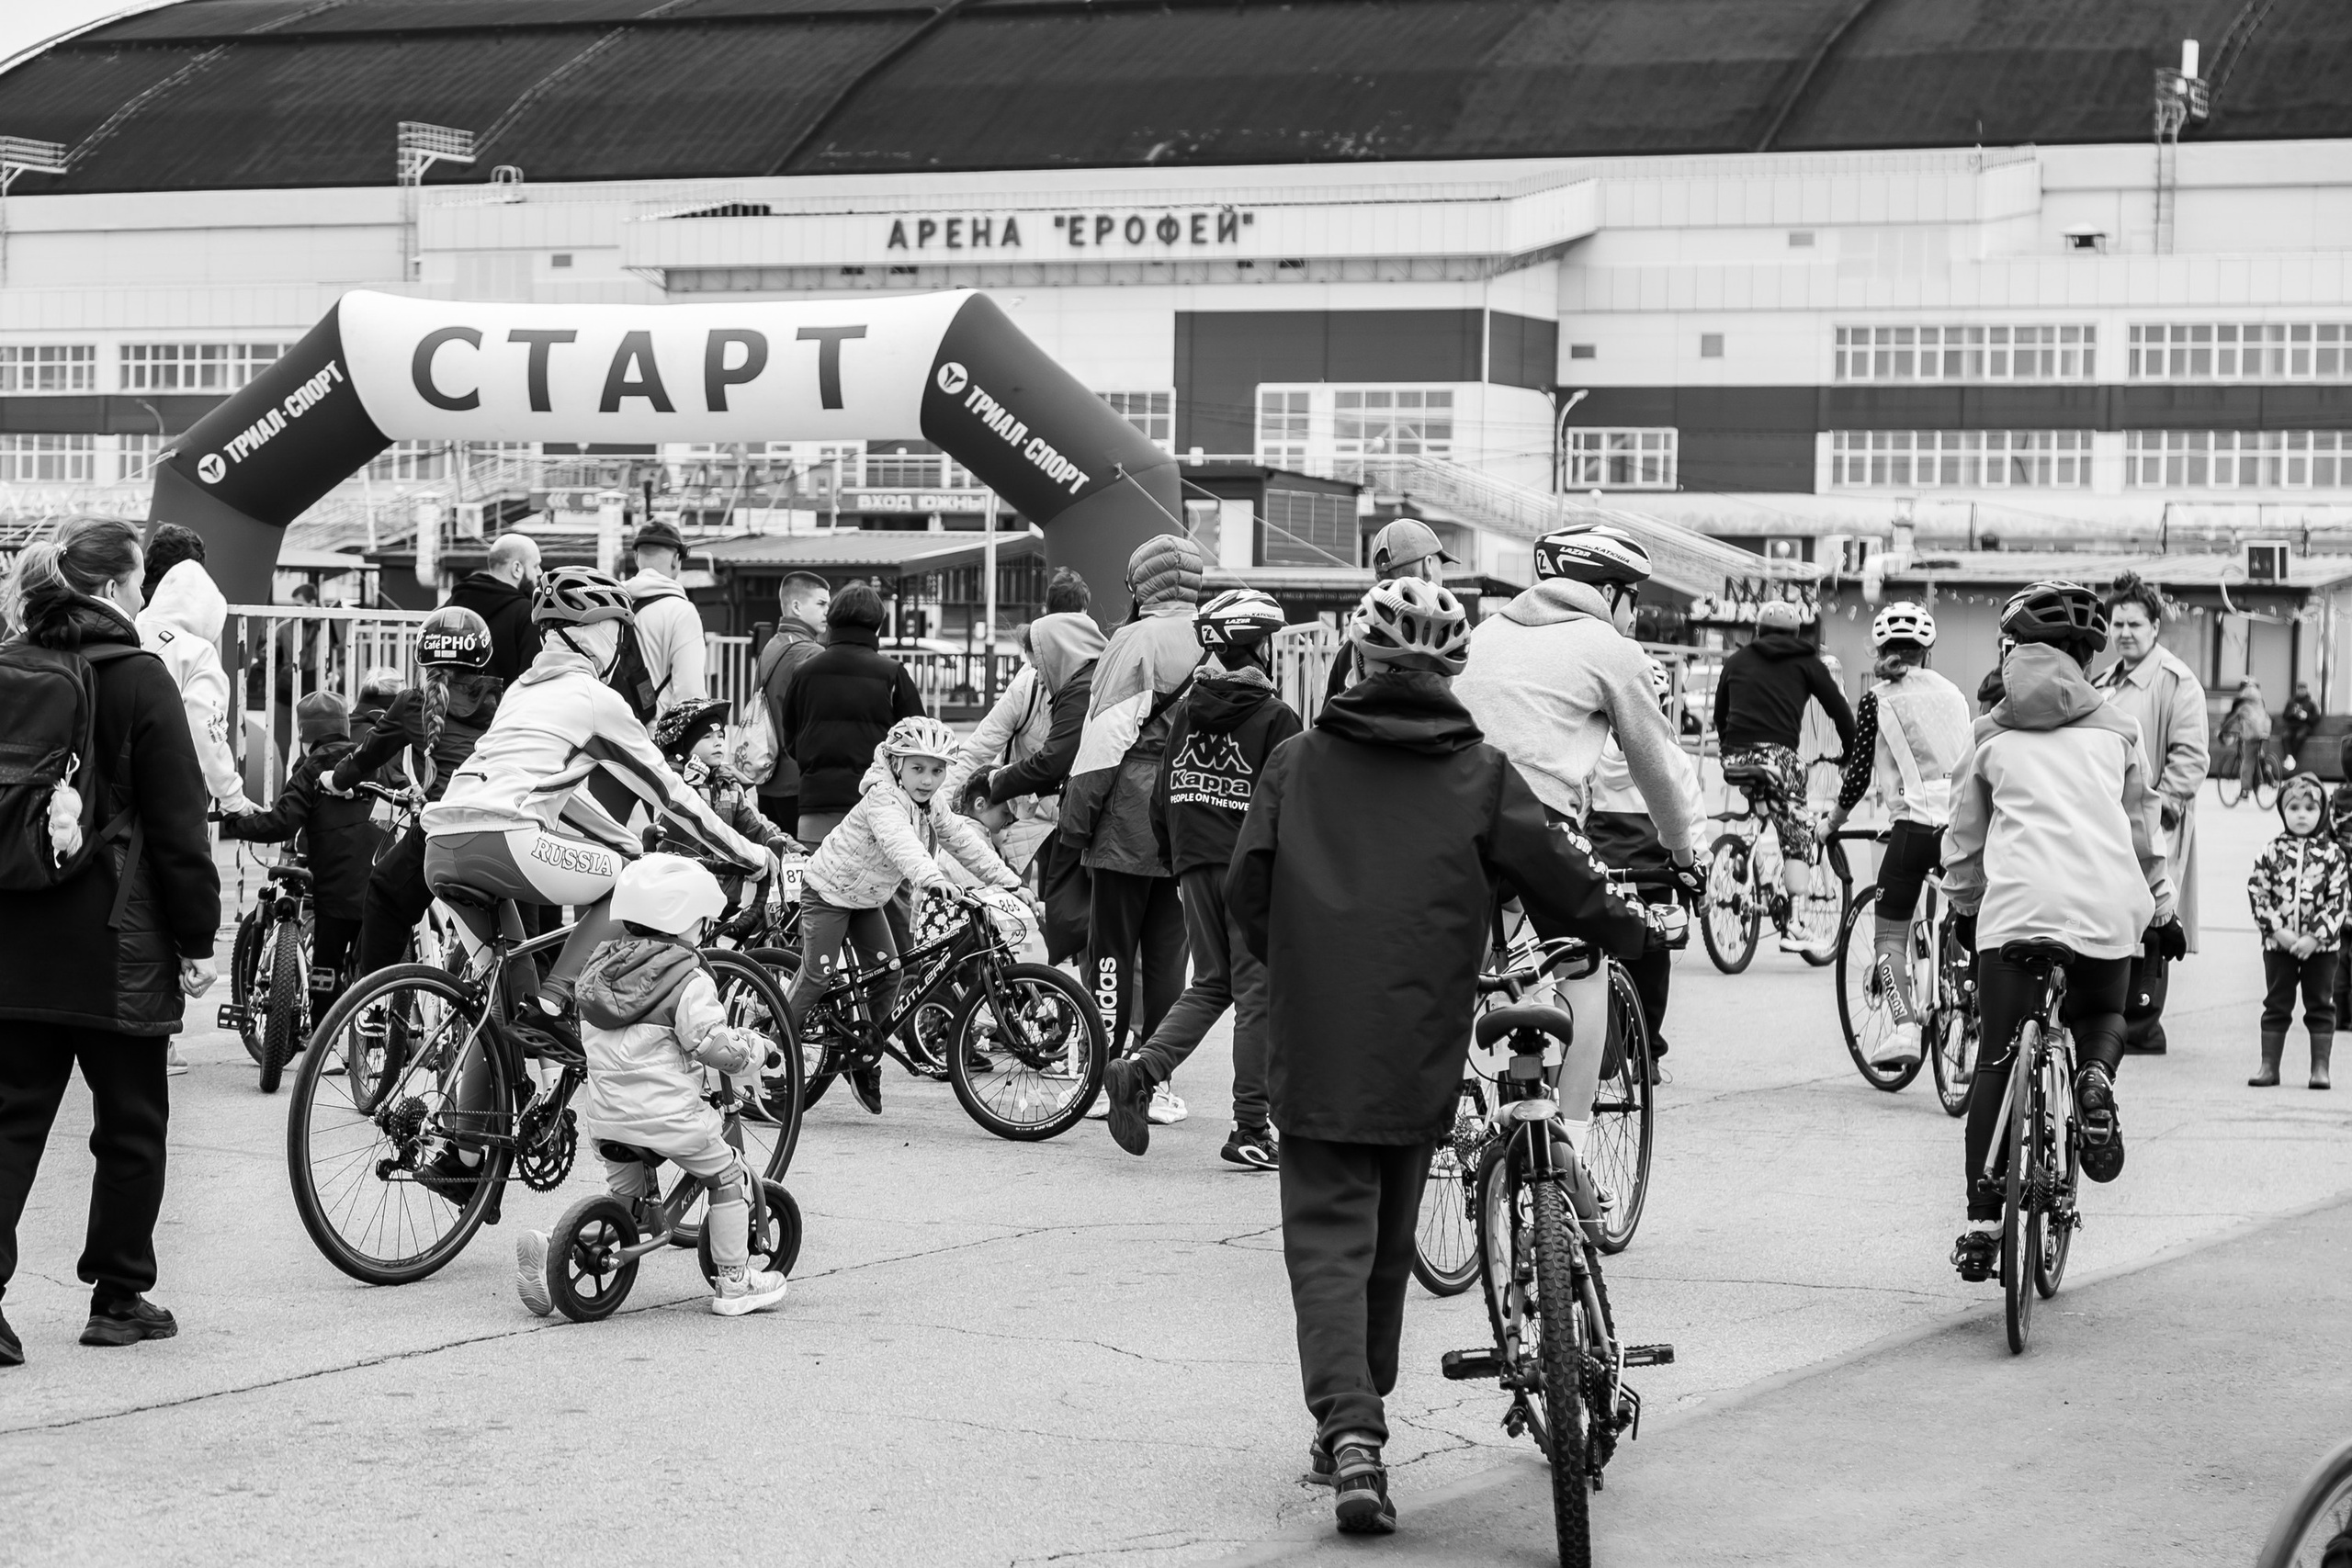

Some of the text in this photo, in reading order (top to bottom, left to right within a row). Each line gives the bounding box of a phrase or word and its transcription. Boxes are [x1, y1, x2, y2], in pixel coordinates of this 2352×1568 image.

[888, 205, 1255, 250] АРЕНА "ЕРОФЕЙ"
[411, 324, 868, 413] СТАРТ
[857, 494, 913, 512] ВХОД
[1559, 546, 1592, 558] LAZER
[1170, 769, 1251, 797] Kappa
[1170, 793, 1194, 805] PEOPLE
[1195, 793, 1210, 804] ON
[1211, 795, 1228, 808] THE
[531, 837, 613, 877] RUSSIA
[999, 899, 1021, 913] 866
